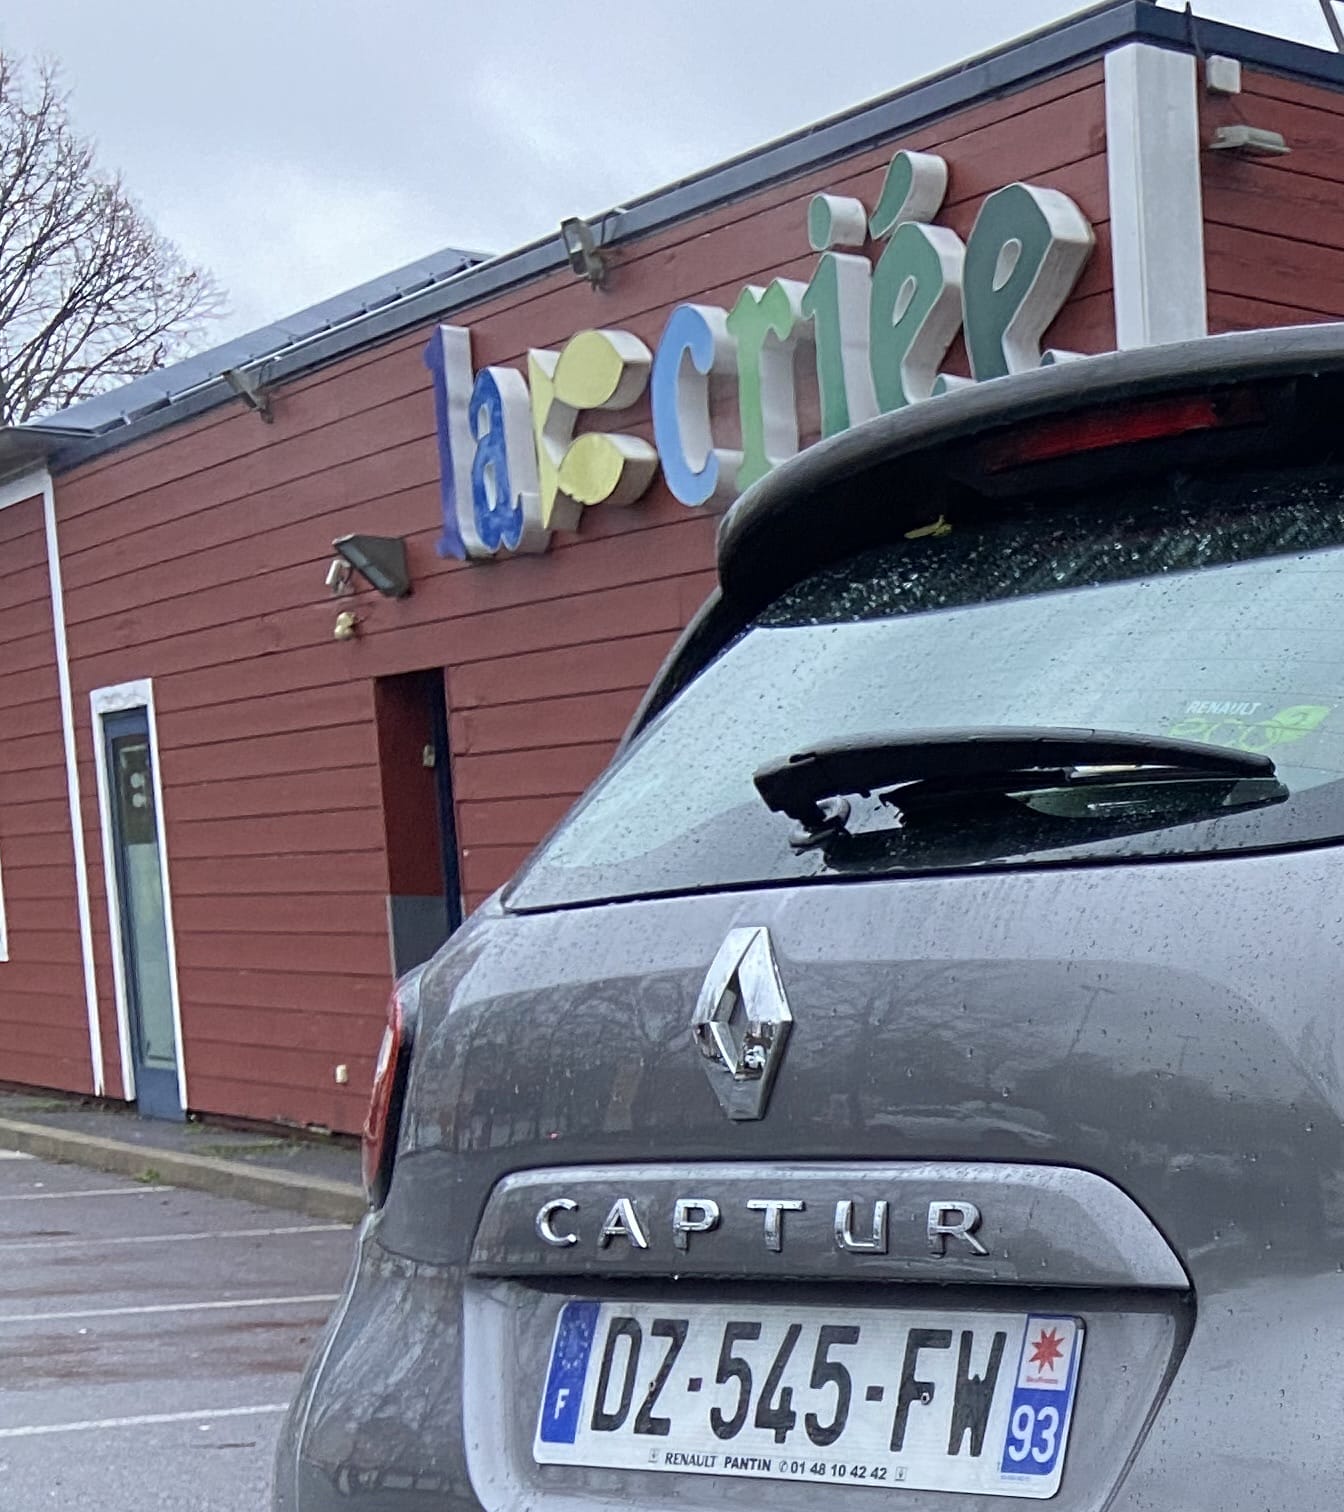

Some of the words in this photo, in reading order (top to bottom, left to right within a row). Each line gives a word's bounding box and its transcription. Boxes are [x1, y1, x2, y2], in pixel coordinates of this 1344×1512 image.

[424, 324, 546, 560] la
[651, 149, 1096, 507] criée
[1185, 700, 1262, 716] RENAULT
[535, 1196, 990, 1257] CAPTUR
[553, 1387, 571, 1420] F
[590, 1315, 1008, 1459] DZ-545-FW
[1008, 1404, 1060, 1464] 93
[664, 1452, 719, 1469] RENAULT
[724, 1456, 772, 1472] PANTIN
[790, 1462, 805, 1475] 01
[809, 1463, 826, 1477] 48
[831, 1464, 847, 1478] 10
[850, 1466, 867, 1480] 42
[871, 1467, 888, 1481] 42
